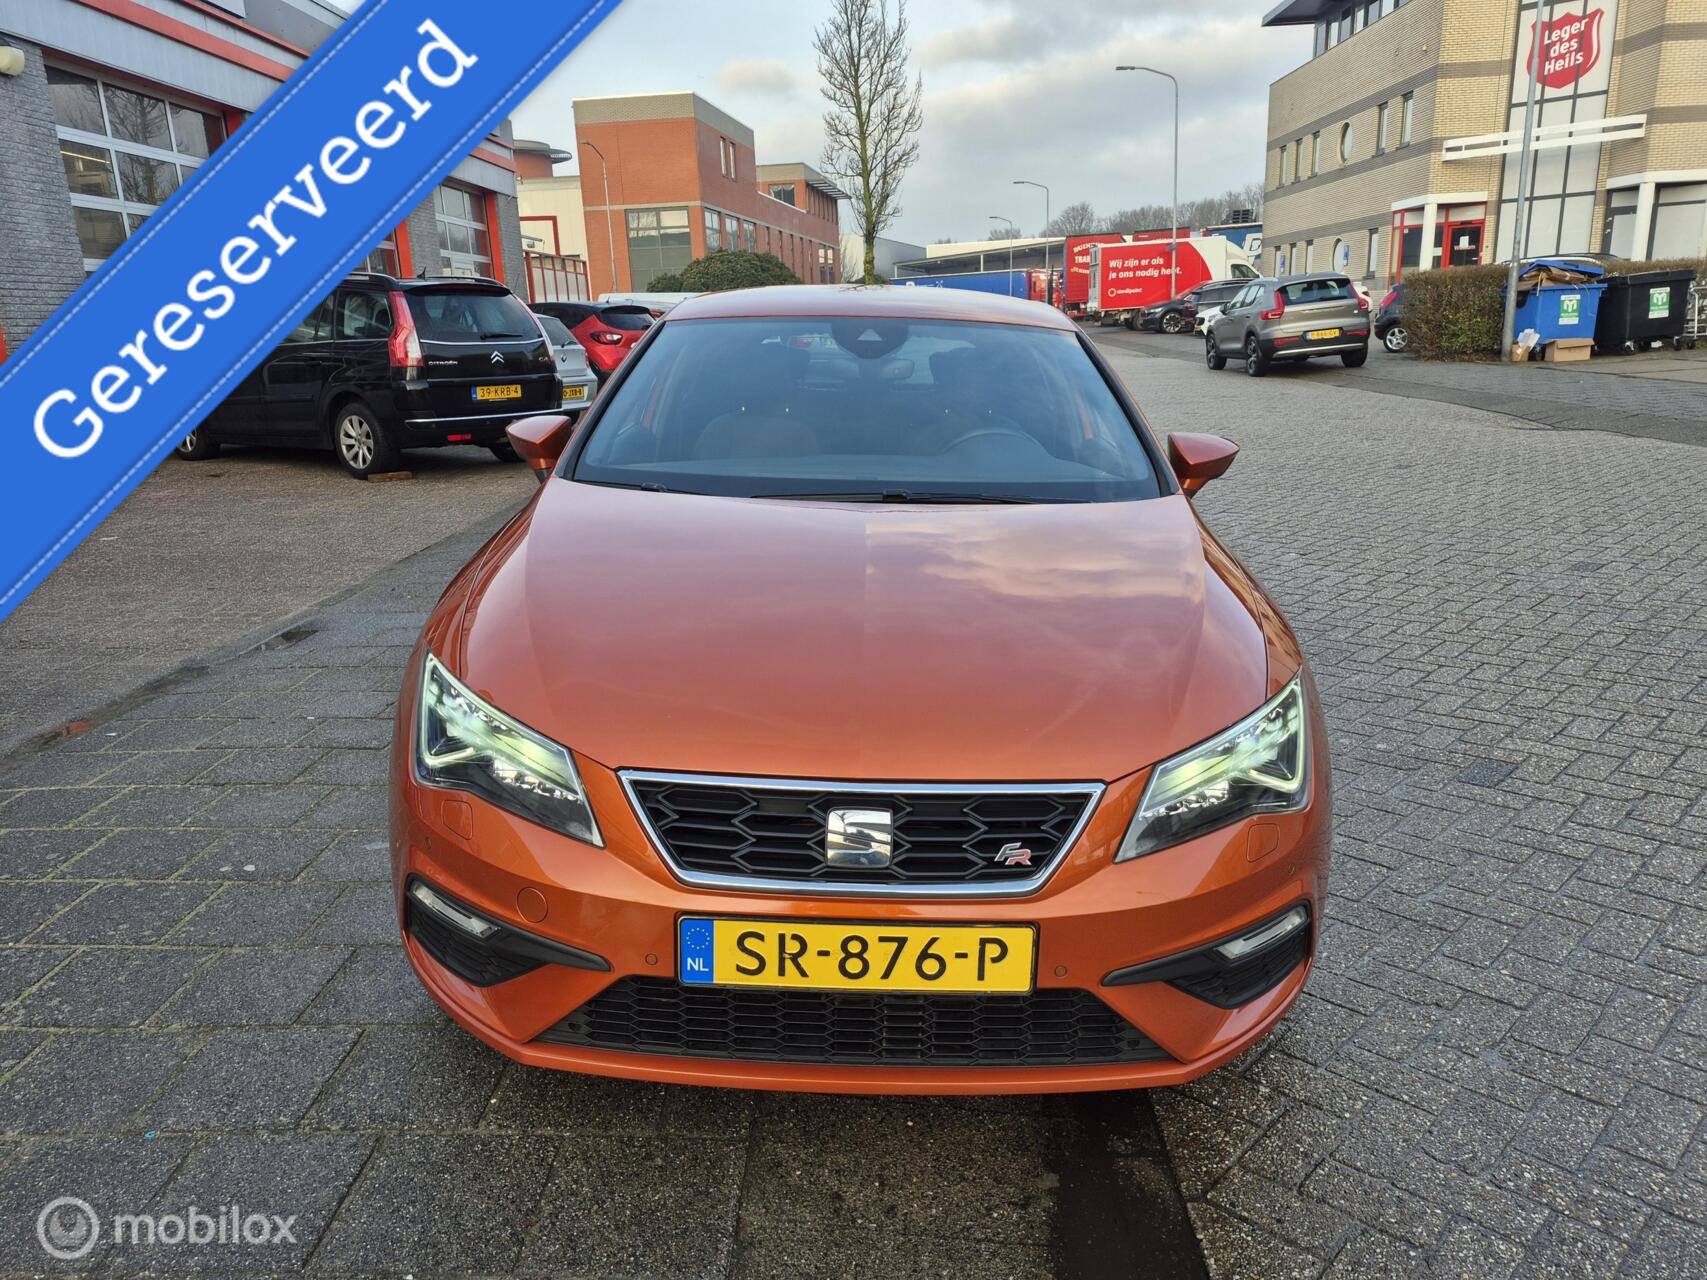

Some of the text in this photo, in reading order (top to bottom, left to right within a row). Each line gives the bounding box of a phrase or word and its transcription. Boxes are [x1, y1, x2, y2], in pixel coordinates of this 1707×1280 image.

[1544, 18, 1589, 45] Leger
[1550, 38, 1578, 57] des
[1544, 52, 1584, 75] Heils
[1109, 256, 1164, 268] Wij zijn er als
[1108, 271, 1117, 280] je
[1118, 270, 1133, 278] ons
[1136, 268, 1159, 278] nodig
[480, 386, 519, 398] 39-KRB-4
[994, 842, 1032, 865] FR
[687, 957, 709, 971] NL
[736, 931, 1008, 981] SR-876-P
